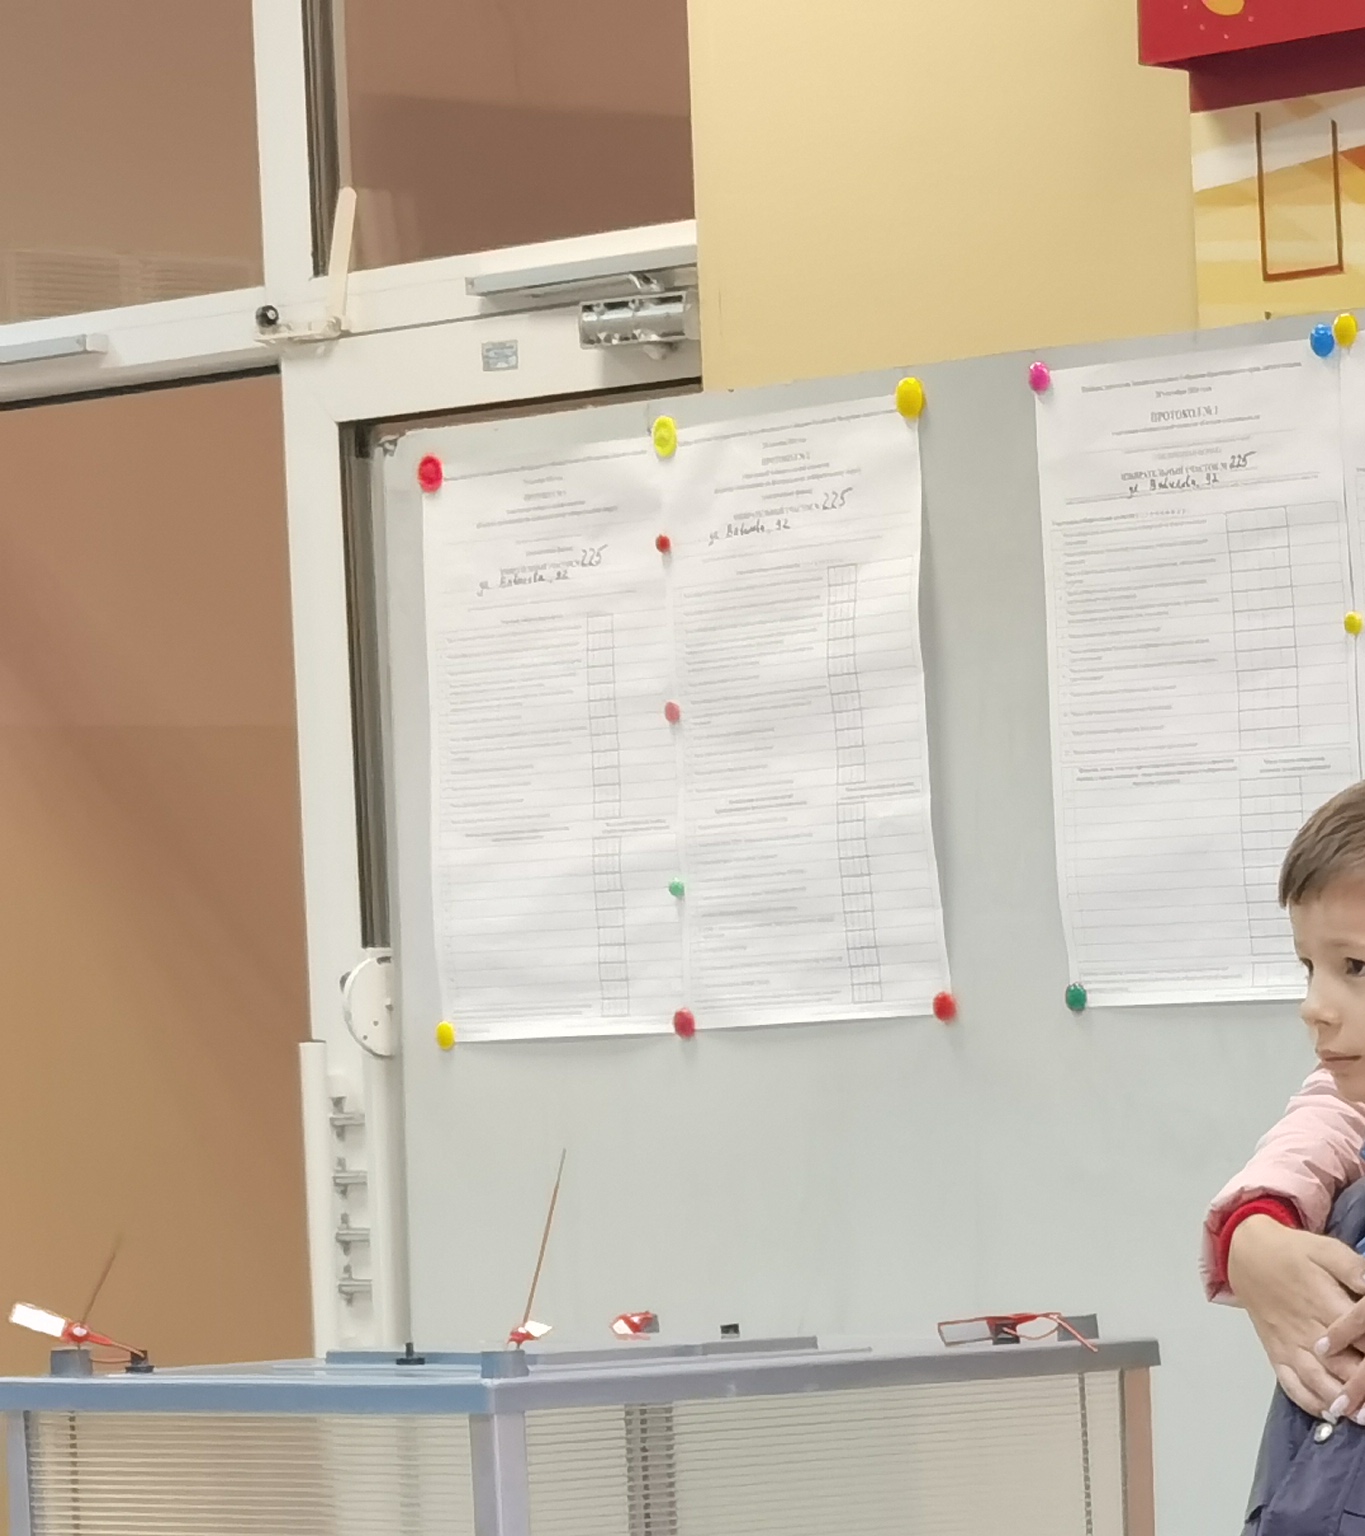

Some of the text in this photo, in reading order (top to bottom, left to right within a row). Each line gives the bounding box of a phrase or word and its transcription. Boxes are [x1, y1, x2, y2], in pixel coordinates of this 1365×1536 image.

[1229, 451, 1257, 470] 225
[822, 487, 853, 510] 225
[581, 544, 609, 568] 225
